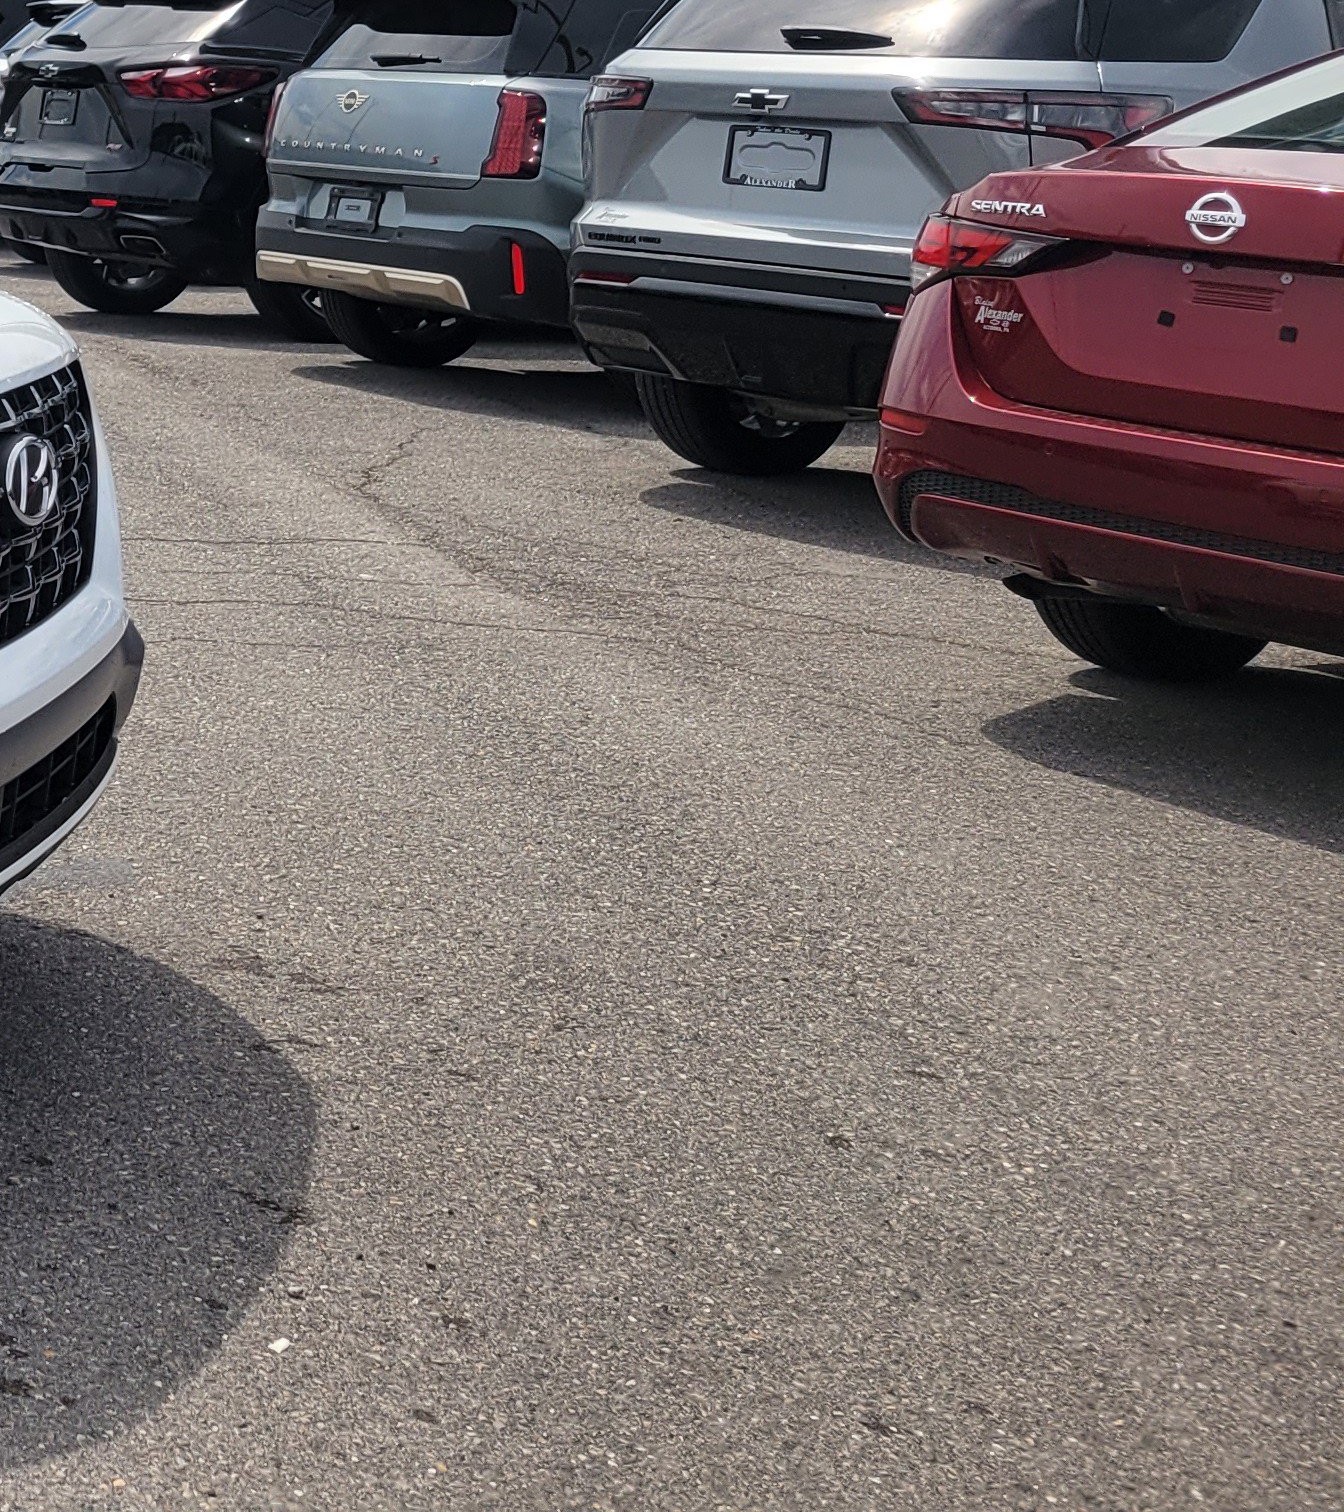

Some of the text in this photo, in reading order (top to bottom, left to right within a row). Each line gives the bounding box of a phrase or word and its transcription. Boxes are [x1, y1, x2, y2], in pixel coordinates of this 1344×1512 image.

[280, 139, 440, 165] COUNTRYMAN S
[744, 176, 796, 188] ALEXANDER
[971, 199, 1047, 218] SENTRA
[1190, 213, 1237, 224] NISSAN
[974, 305, 1024, 323] Alexander
